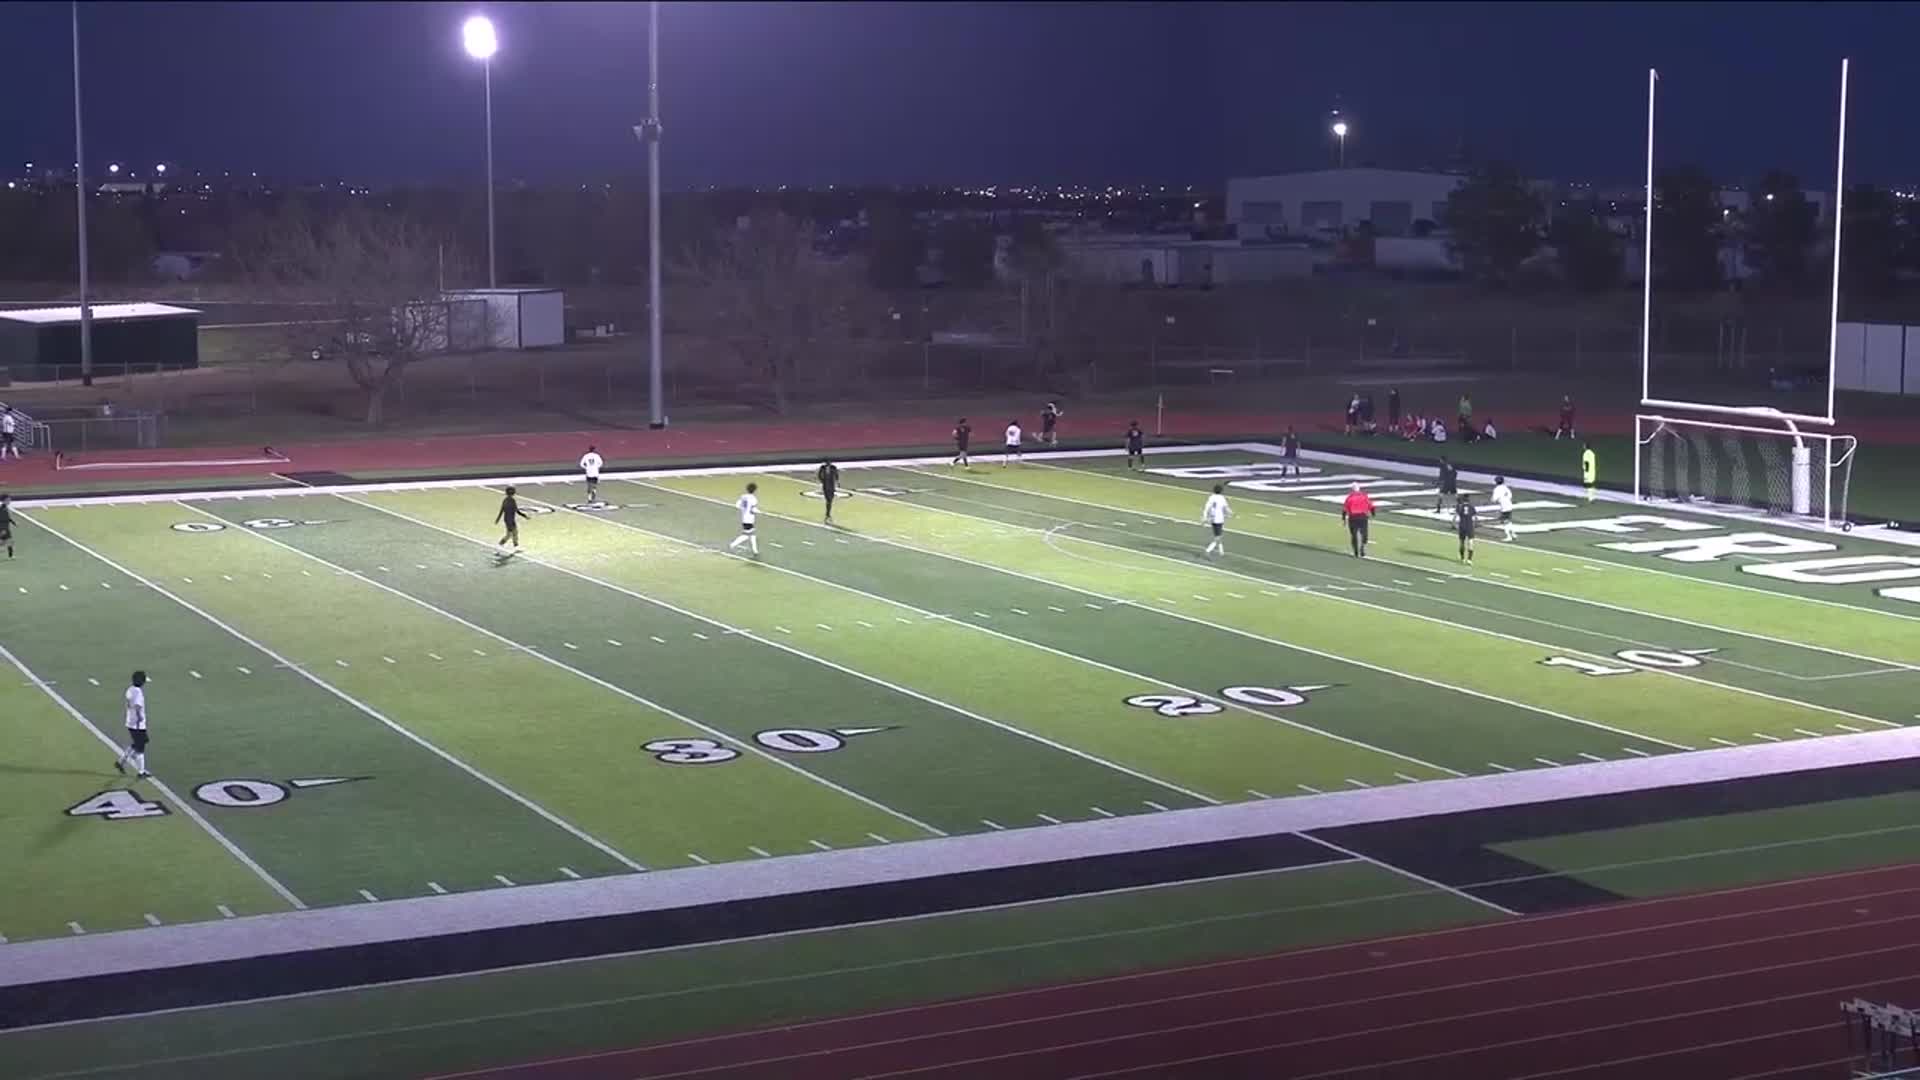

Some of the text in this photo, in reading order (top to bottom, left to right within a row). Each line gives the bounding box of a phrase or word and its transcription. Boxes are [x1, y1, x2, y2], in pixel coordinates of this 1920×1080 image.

[1538, 650, 1705, 676] 10
[1122, 686, 1308, 717] 20
[641, 729, 846, 764] 30
[65, 778, 291, 820] 40
